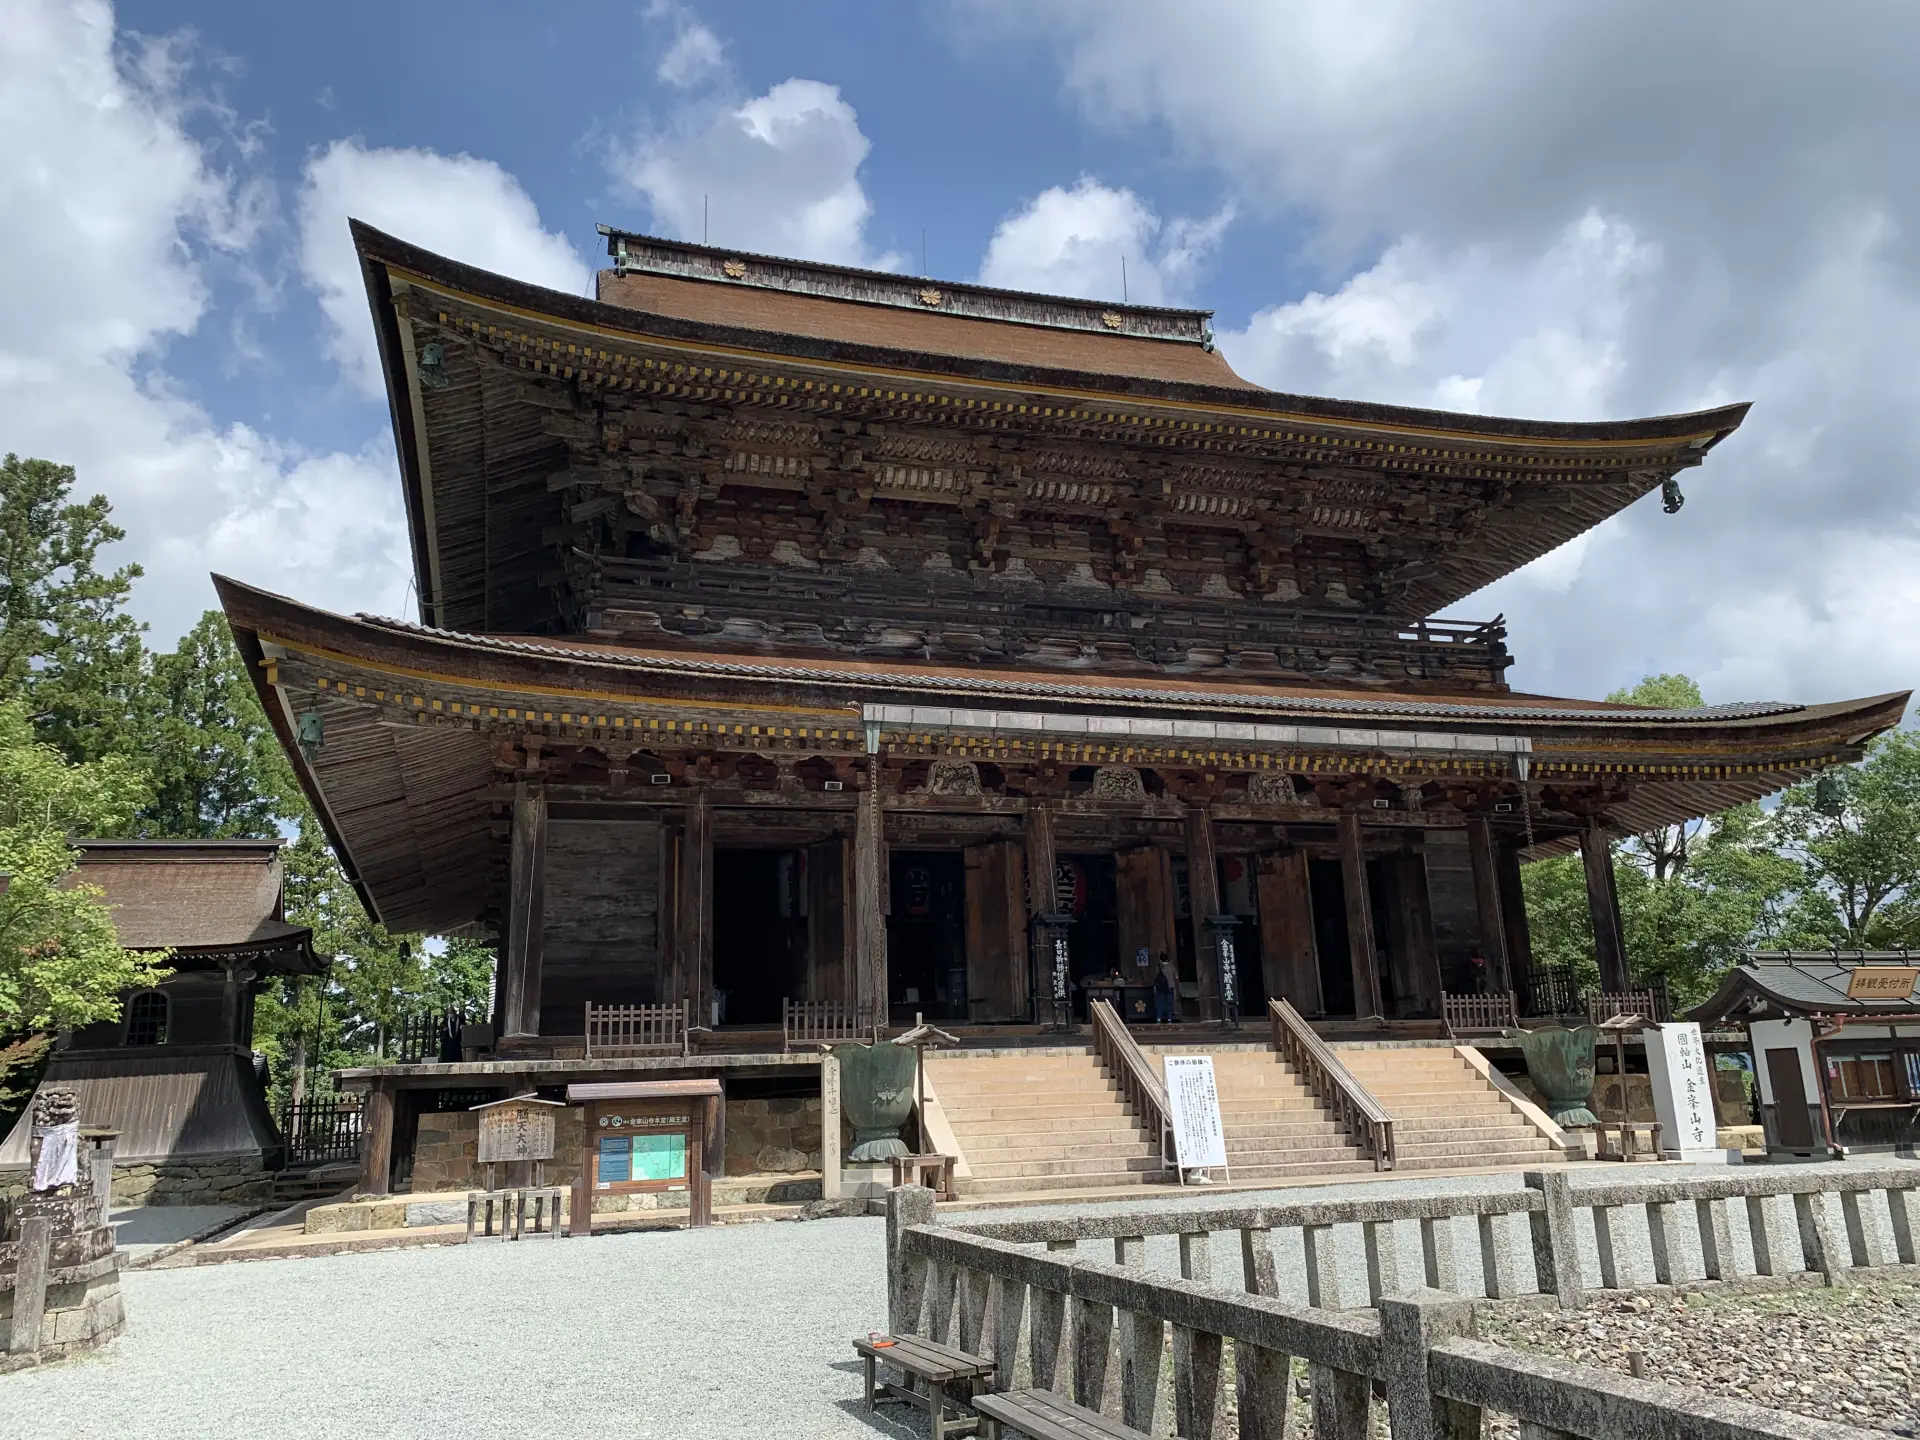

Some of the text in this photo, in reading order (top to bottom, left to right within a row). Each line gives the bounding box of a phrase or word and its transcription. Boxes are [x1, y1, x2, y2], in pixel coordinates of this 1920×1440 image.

[1854, 977, 1912, 989] 拝観受付所
[515, 1108, 529, 1157] 脳天大神
[1685, 1078, 1704, 1143] 金峯山寺
